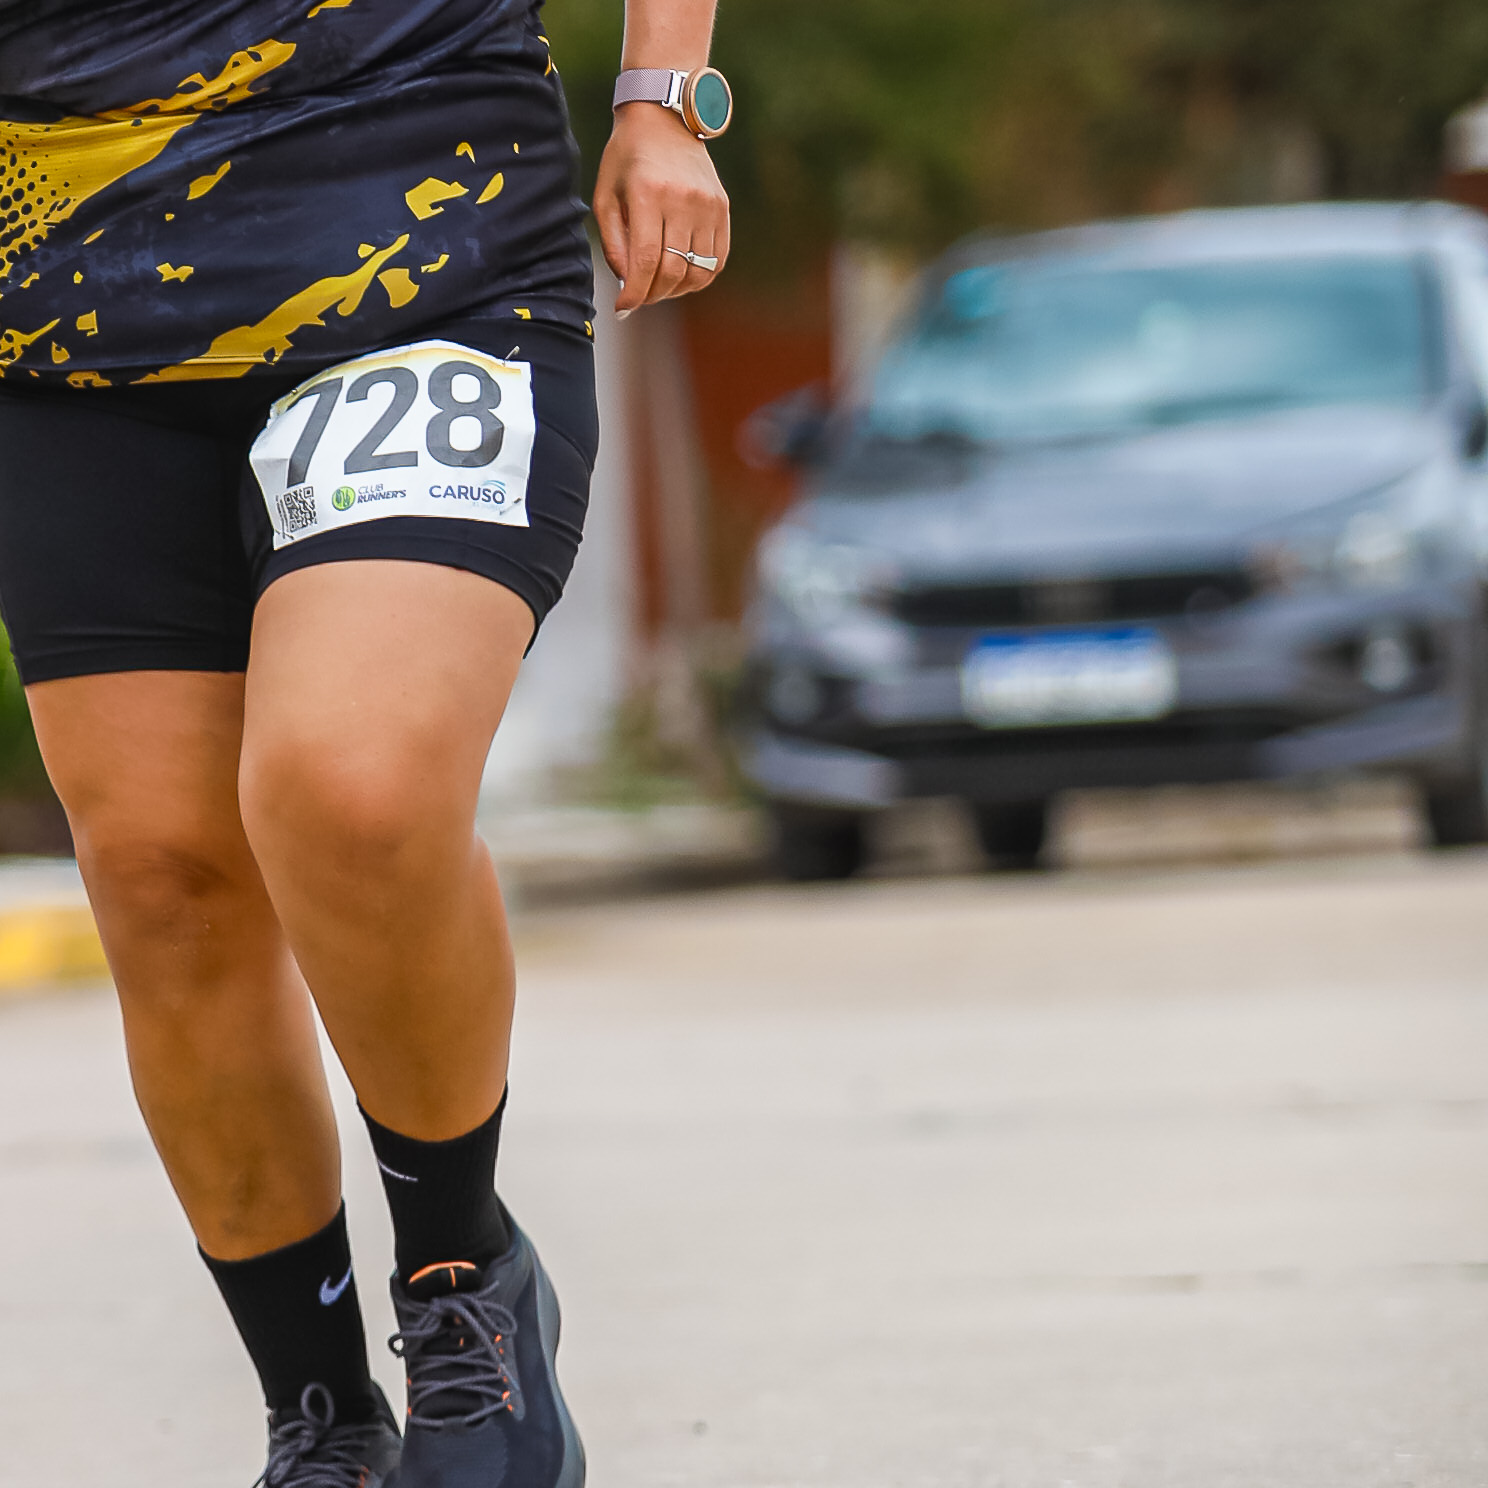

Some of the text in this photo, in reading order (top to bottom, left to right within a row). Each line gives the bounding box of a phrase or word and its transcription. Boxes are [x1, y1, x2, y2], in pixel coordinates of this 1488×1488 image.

[285, 360, 505, 489] 728
[357, 483, 385, 496] CLUB
[428, 484, 506, 505] CARUSO
